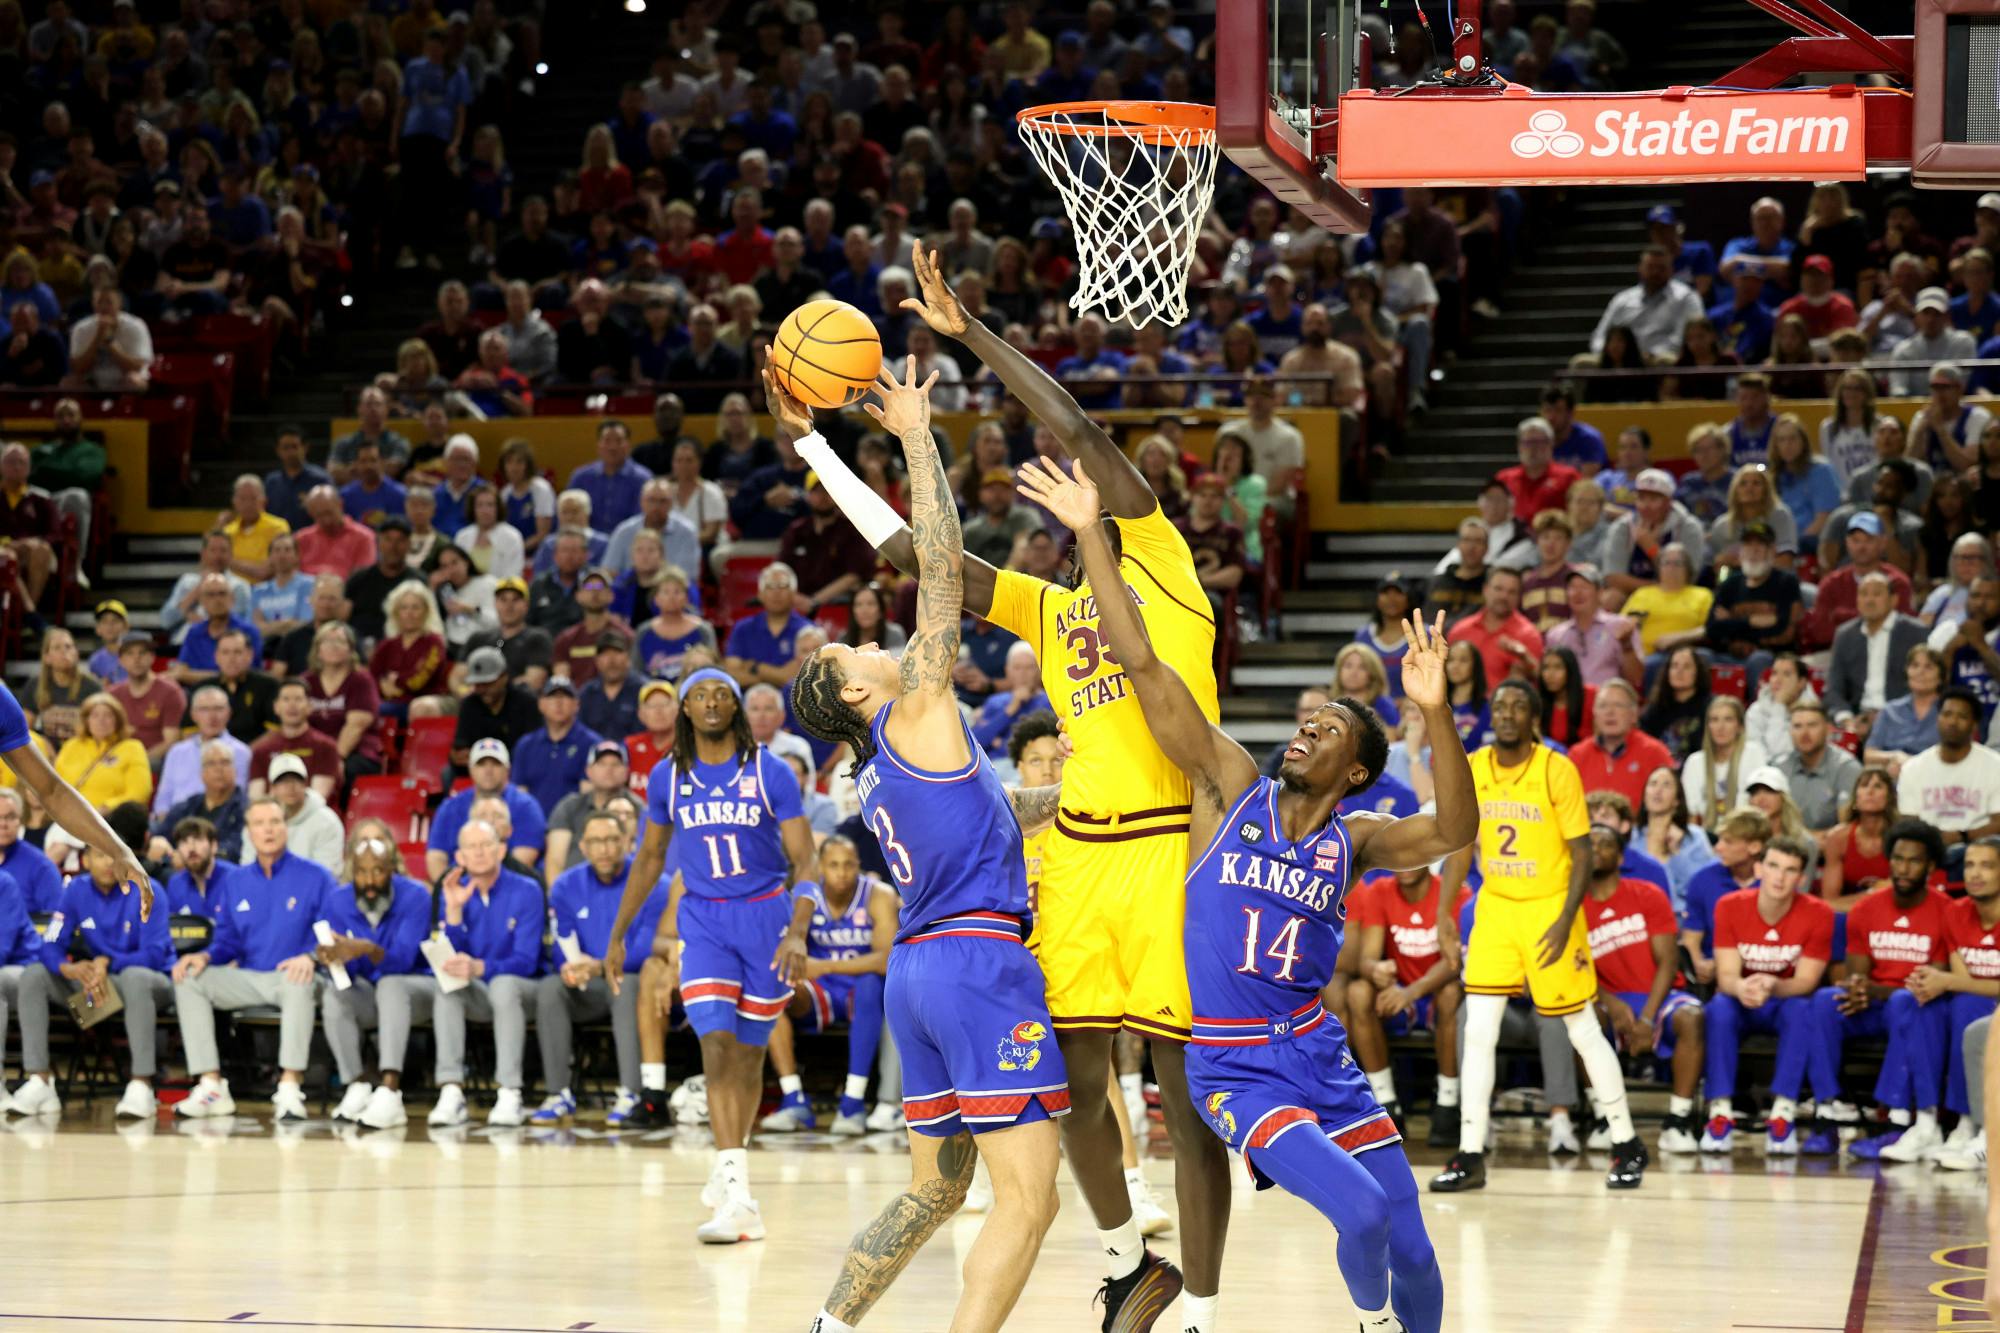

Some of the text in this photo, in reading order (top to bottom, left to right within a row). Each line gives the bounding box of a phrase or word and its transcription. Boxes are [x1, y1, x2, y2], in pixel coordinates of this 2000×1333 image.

[1591, 107, 1849, 157] State Farm
[1056, 583, 1145, 640] ARIZA
[1071, 672, 1137, 717] STAT
[678, 800, 761, 830] KANSAS
[1481, 802, 1543, 821] RIZONA
[872, 806, 912, 883] 3
[1240, 823, 1262, 842] SW
[1497, 824, 1518, 857] 2
[702, 832, 747, 879] 11
[1219, 852, 1336, 912] KANSAS
[1237, 907, 1306, 981] 14
[1869, 931, 1931, 951] KANSAS
[1273, 1018, 1291, 1035] KU
[1012, 1047, 1027, 1058] KU
